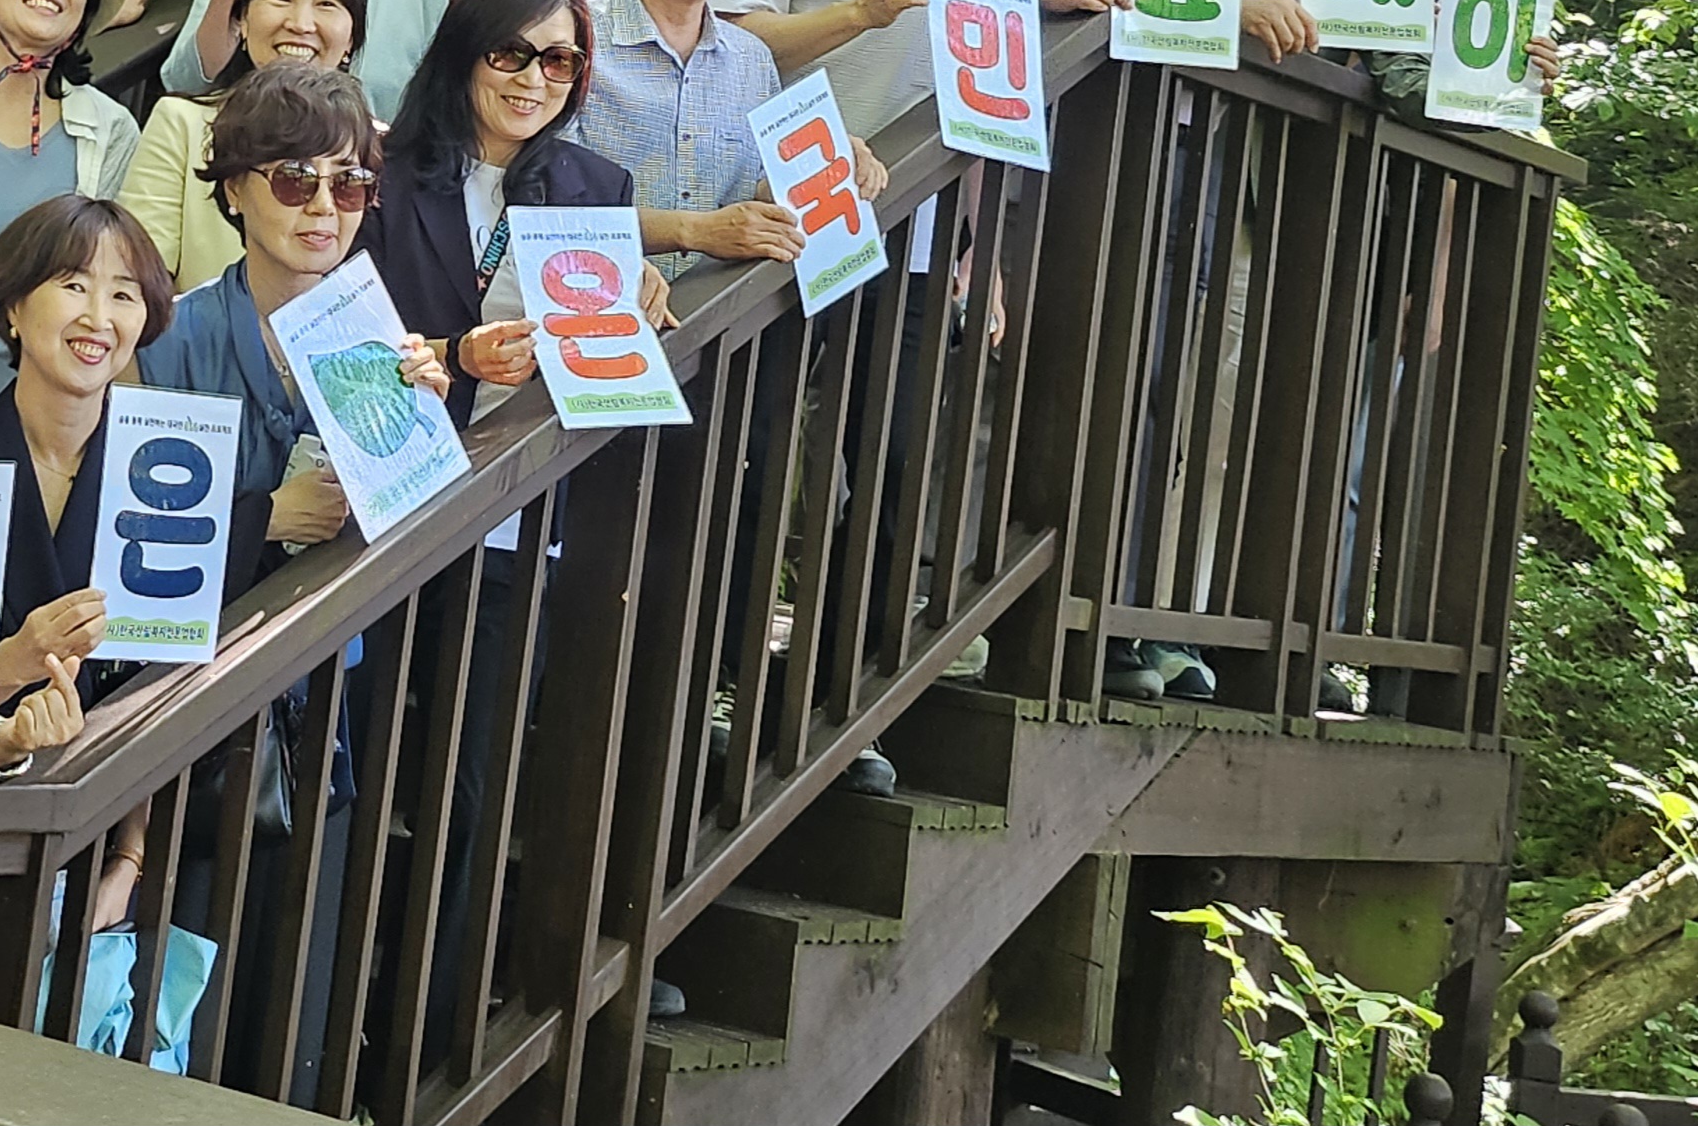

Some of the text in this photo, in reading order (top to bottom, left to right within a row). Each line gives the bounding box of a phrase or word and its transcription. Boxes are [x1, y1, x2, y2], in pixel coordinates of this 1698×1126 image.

[778, 116, 861, 235] 국
[542, 249, 648, 379] 온
[115, 437, 216, 598] 은
